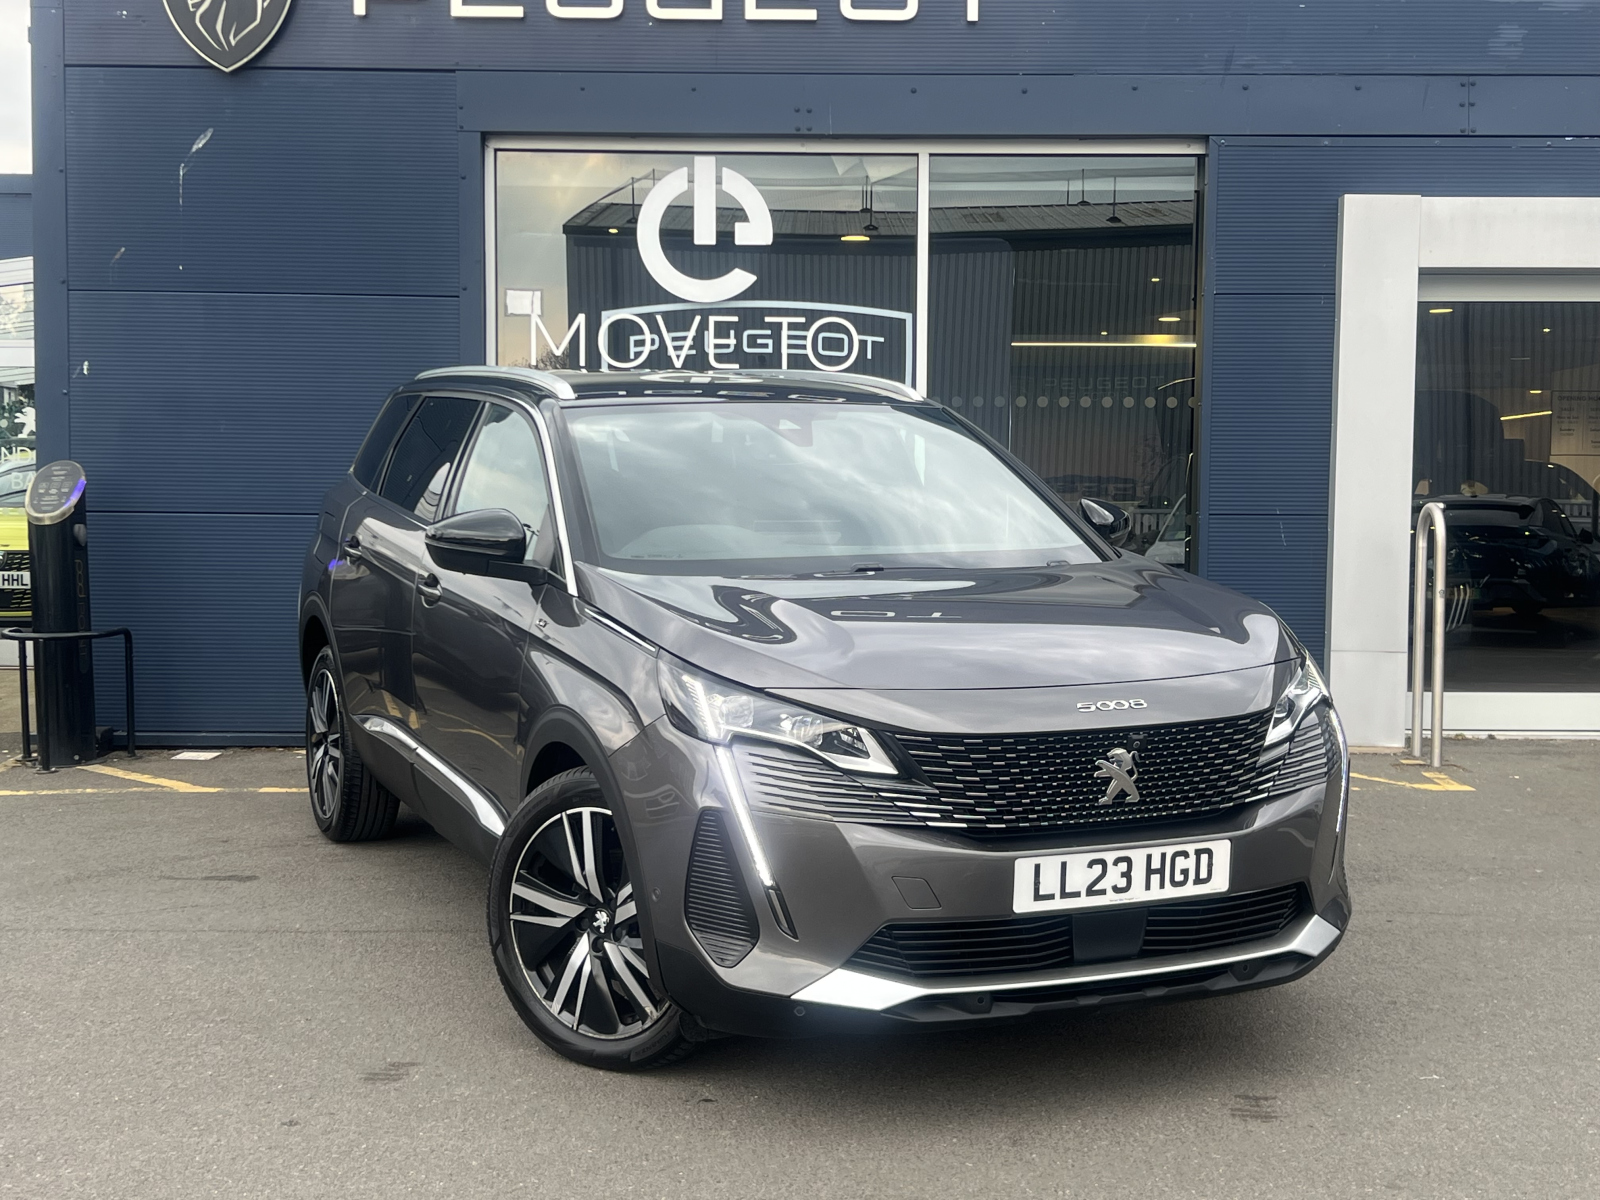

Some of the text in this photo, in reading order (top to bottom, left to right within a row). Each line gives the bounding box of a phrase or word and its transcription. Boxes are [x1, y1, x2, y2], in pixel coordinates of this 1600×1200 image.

[530, 313, 859, 372] MOVE TO
[629, 330, 885, 360] PEUGEOT
[1, 446, 37, 464] ND
[2, 574, 29, 586] HHL
[77, 602, 88, 658] PONT
[1076, 699, 1148, 713] 5008
[1033, 847, 1214, 902] LL23 HGD
